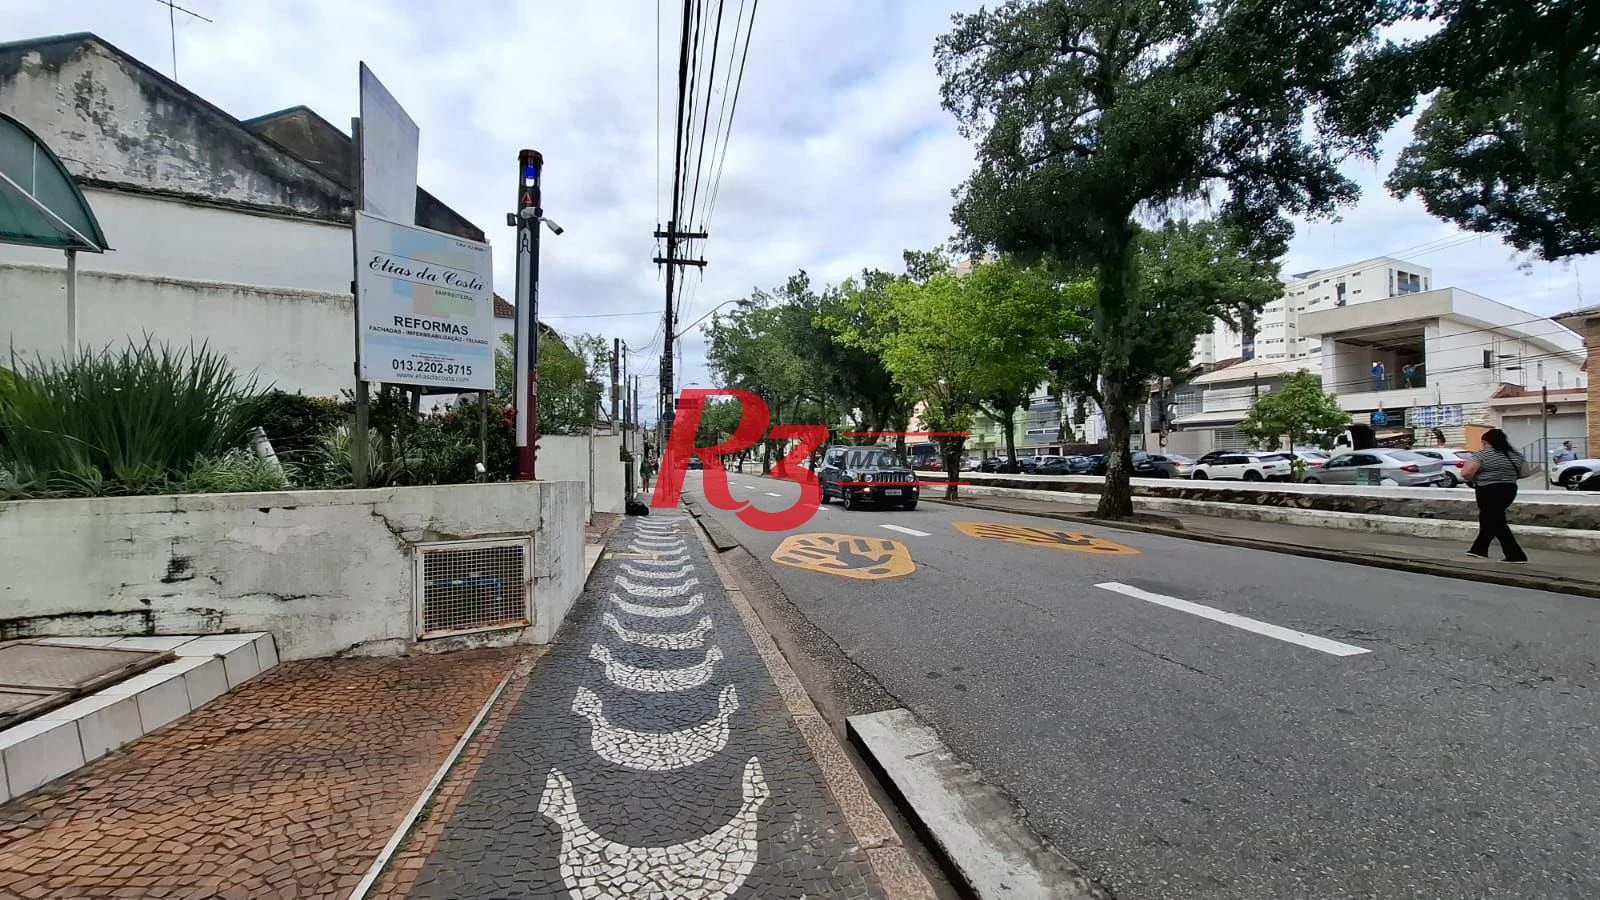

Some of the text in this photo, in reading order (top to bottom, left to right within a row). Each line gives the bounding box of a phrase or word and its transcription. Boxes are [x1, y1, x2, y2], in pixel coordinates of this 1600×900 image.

[369, 255, 485, 291] Elias da Costa
[435, 289, 473, 301] EMPREITEIRA
[369, 325, 402, 335] FACHADAS
[405, 330, 462, 343] IMPERMEABILIZAÇÃO
[393, 315, 469, 336] REFORMAS
[392, 358, 473, 376] 013.2202-8715
[396, 371, 470, 383] www.eliasdacosta.com
